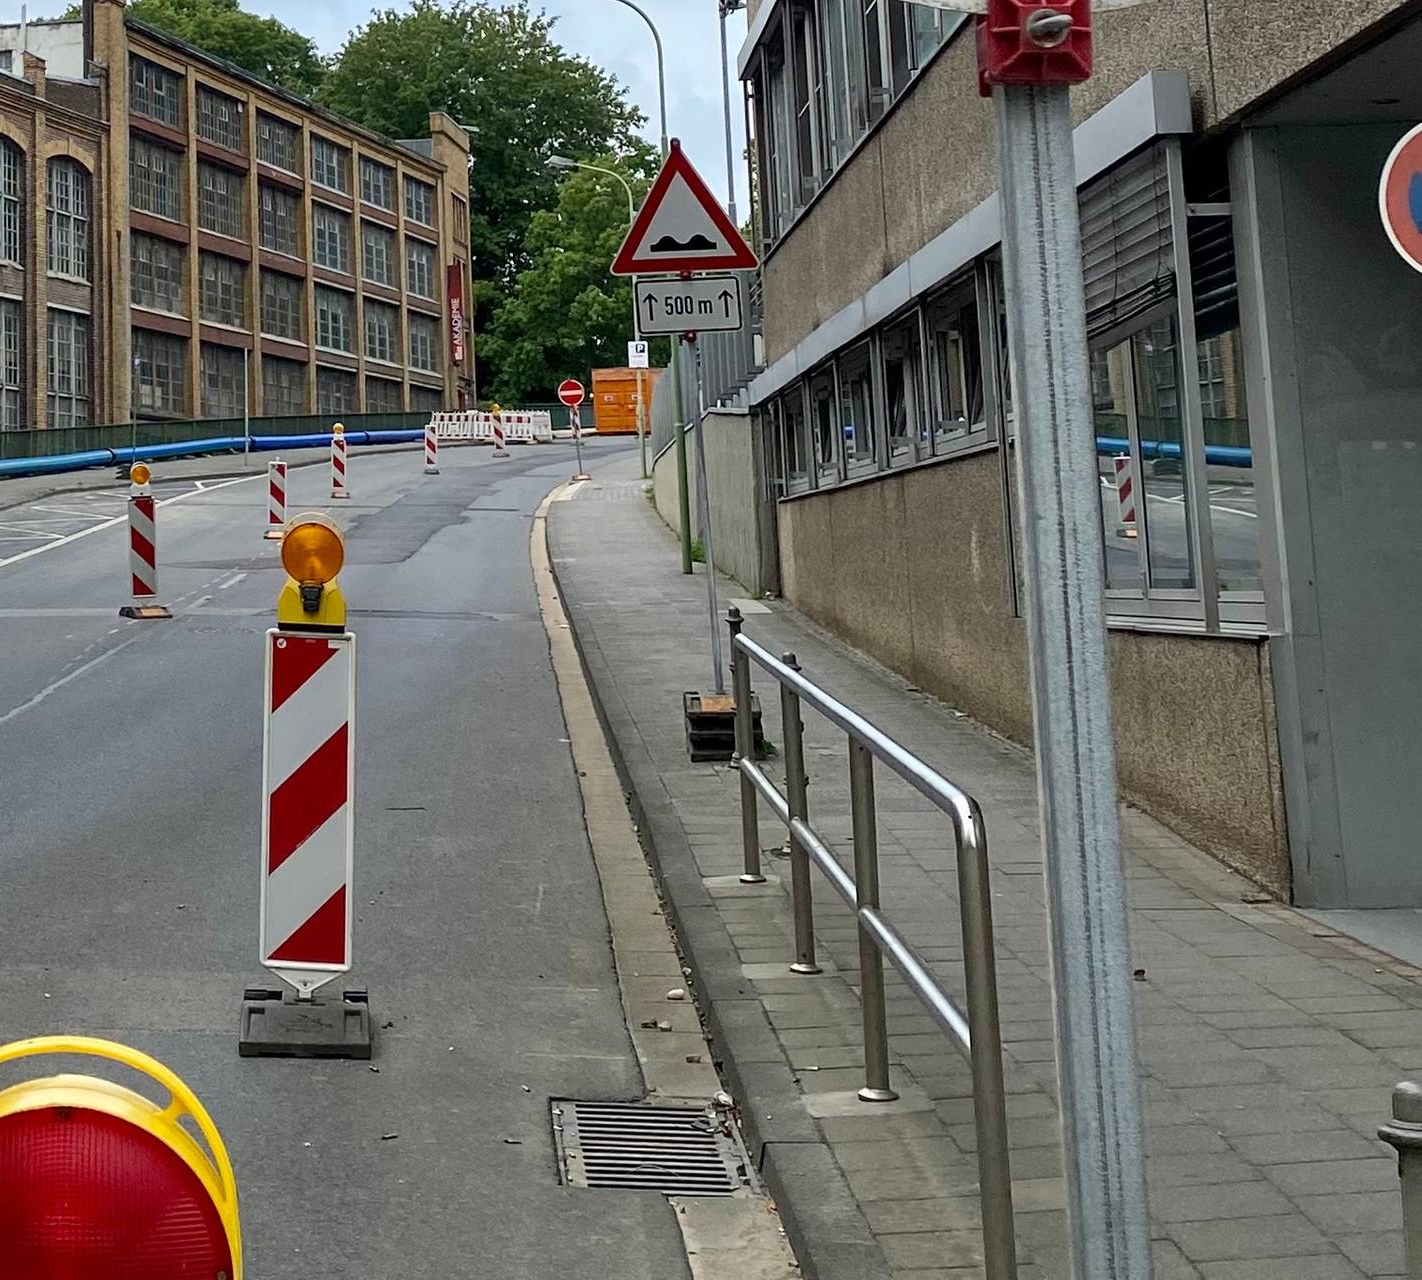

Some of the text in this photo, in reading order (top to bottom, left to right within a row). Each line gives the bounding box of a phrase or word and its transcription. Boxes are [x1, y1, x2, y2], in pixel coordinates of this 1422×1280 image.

[451, 298, 462, 345] AKADEMIE
[664, 295, 713, 315] 500 m
